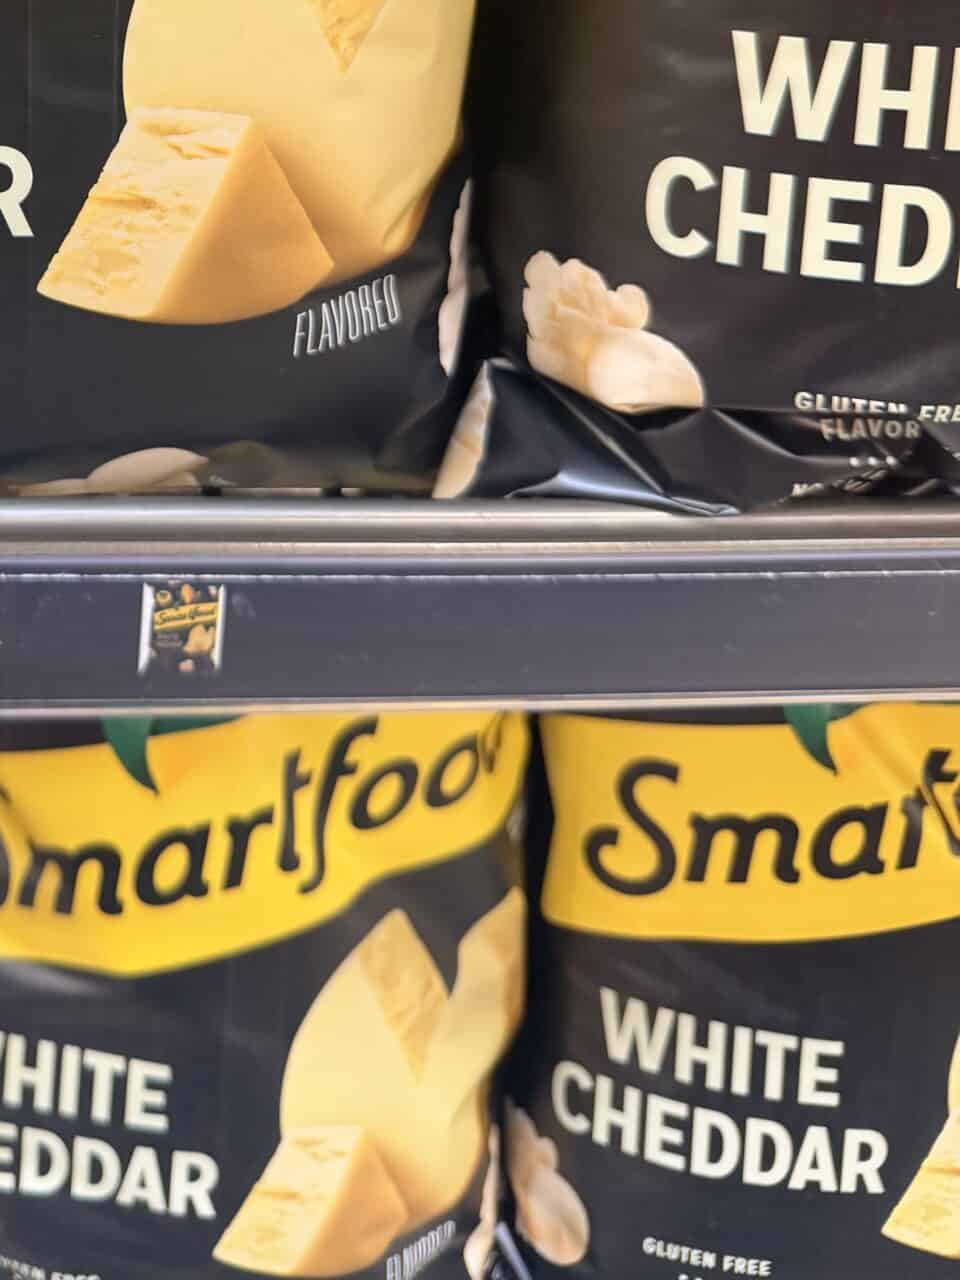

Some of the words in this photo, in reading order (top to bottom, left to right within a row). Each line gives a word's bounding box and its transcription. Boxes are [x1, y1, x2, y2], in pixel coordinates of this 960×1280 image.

[645, 156, 960, 289] CHED
[293, 274, 400, 358] FLAVORED
[794, 391, 909, 414] GLUTEN
[599, 986, 845, 1108] WHITE
[551, 1061, 889, 1194] CHEDDAR
[642, 1236, 717, 1269] GLUTEN
[722, 1254, 773, 1277] FREE
